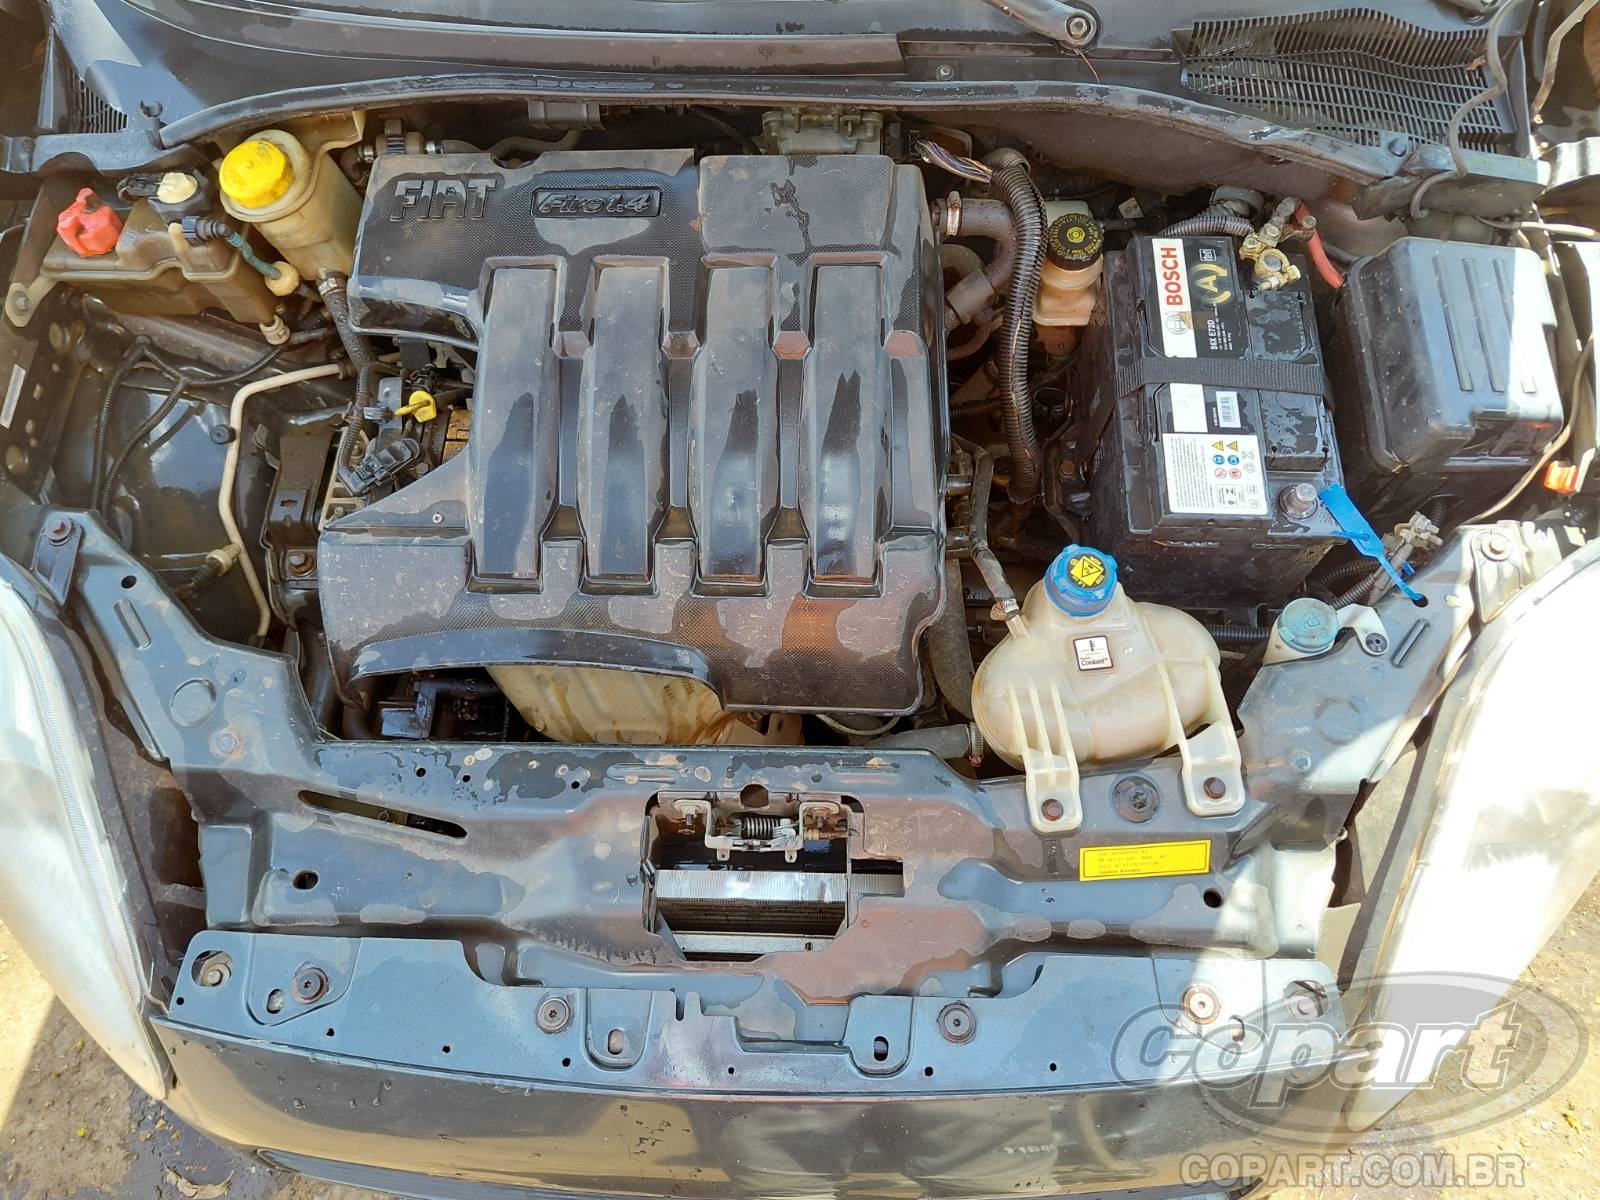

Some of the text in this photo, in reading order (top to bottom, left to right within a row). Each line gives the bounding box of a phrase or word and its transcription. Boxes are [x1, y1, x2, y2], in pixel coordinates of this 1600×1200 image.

[390, 178, 497, 222] FIAT
[1160, 247, 1183, 306] BOSCH
[1206, 319, 1218, 351] S6X E72D
